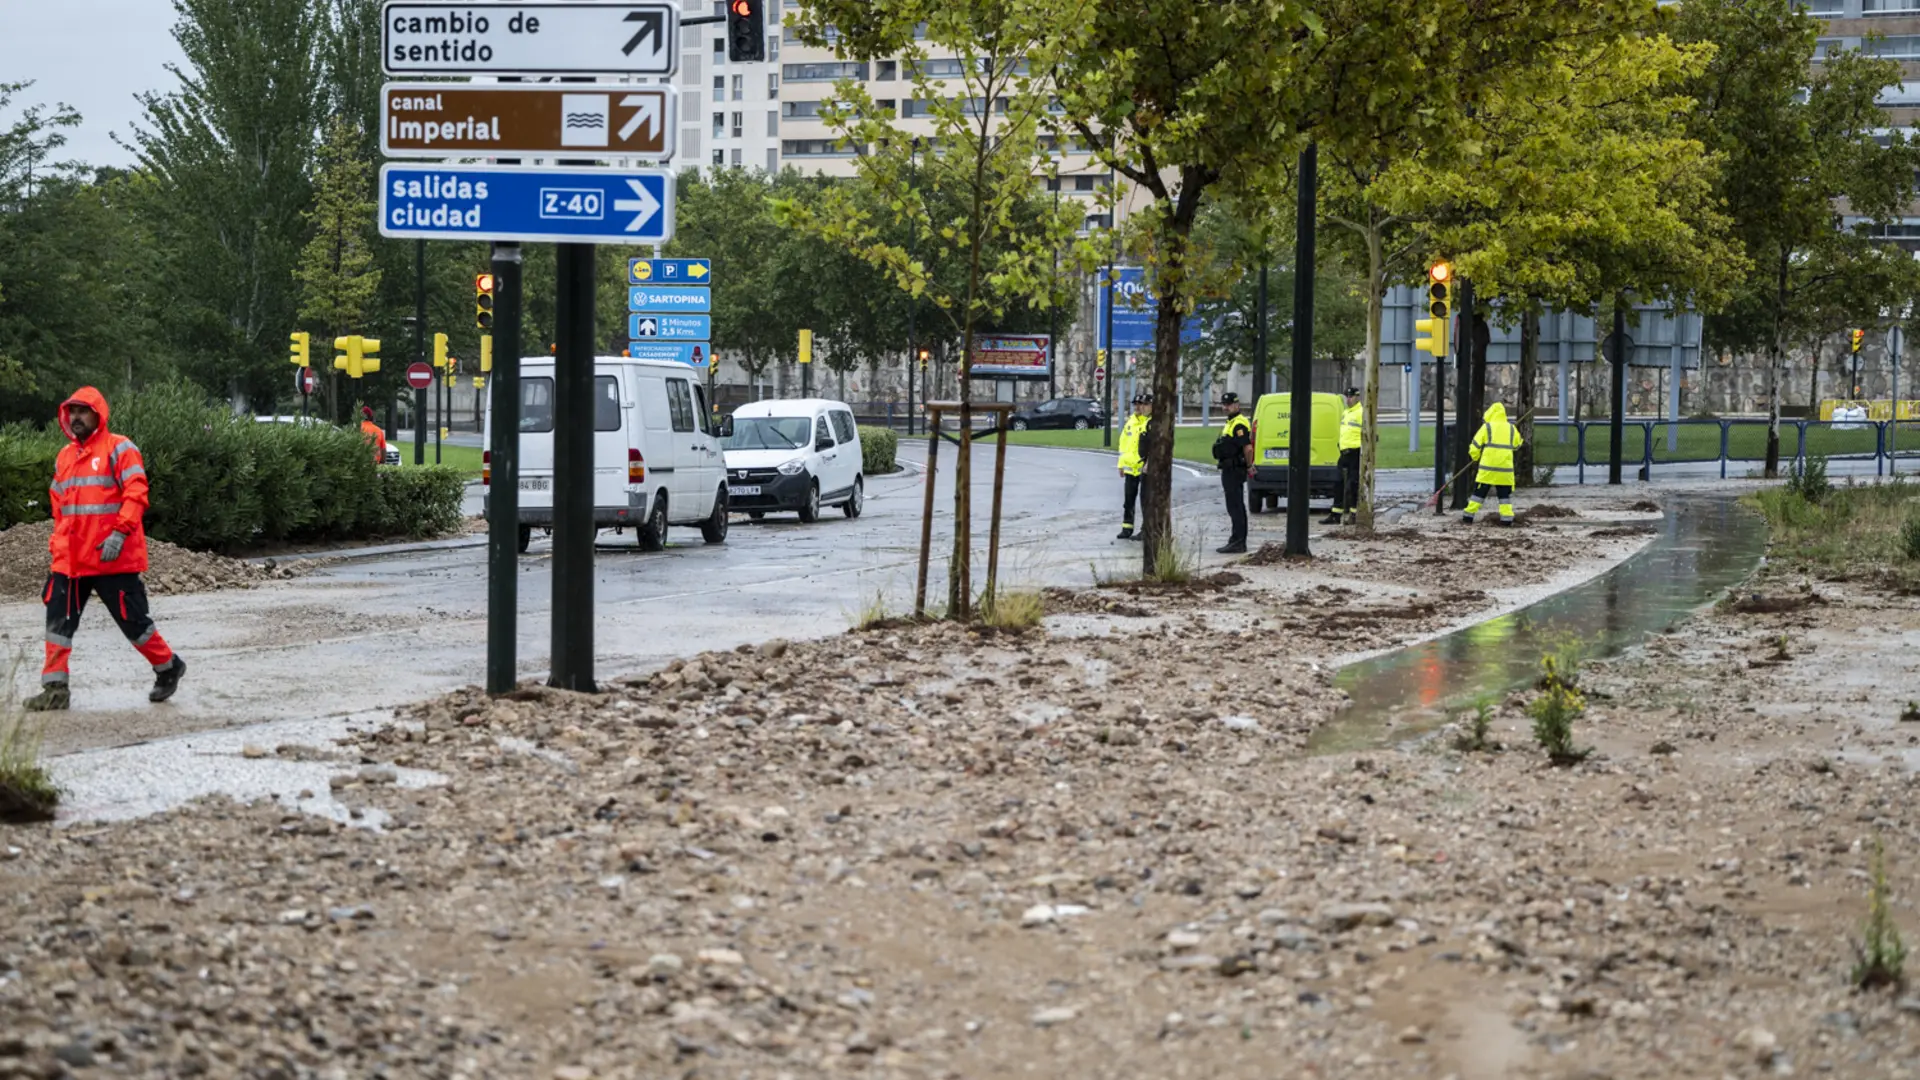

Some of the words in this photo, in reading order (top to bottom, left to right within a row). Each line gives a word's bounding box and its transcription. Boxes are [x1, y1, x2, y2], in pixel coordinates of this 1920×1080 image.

[393, 11, 489, 34] cambio
[508, 11, 540, 34] de
[393, 39, 493, 62] sentido
[391, 94, 443, 111] canal
[390, 116, 500, 144] Imperial
[392, 175, 488, 200] salidas
[544, 193, 599, 214] Z-40
[391, 203, 481, 228] ciudad
[665, 265, 675, 276] P
[649, 295, 706, 304] SARTOPINA
[662, 318, 667, 326] 5
[669, 318, 701, 327] Minutos
[662, 328, 675, 336] 2,5
